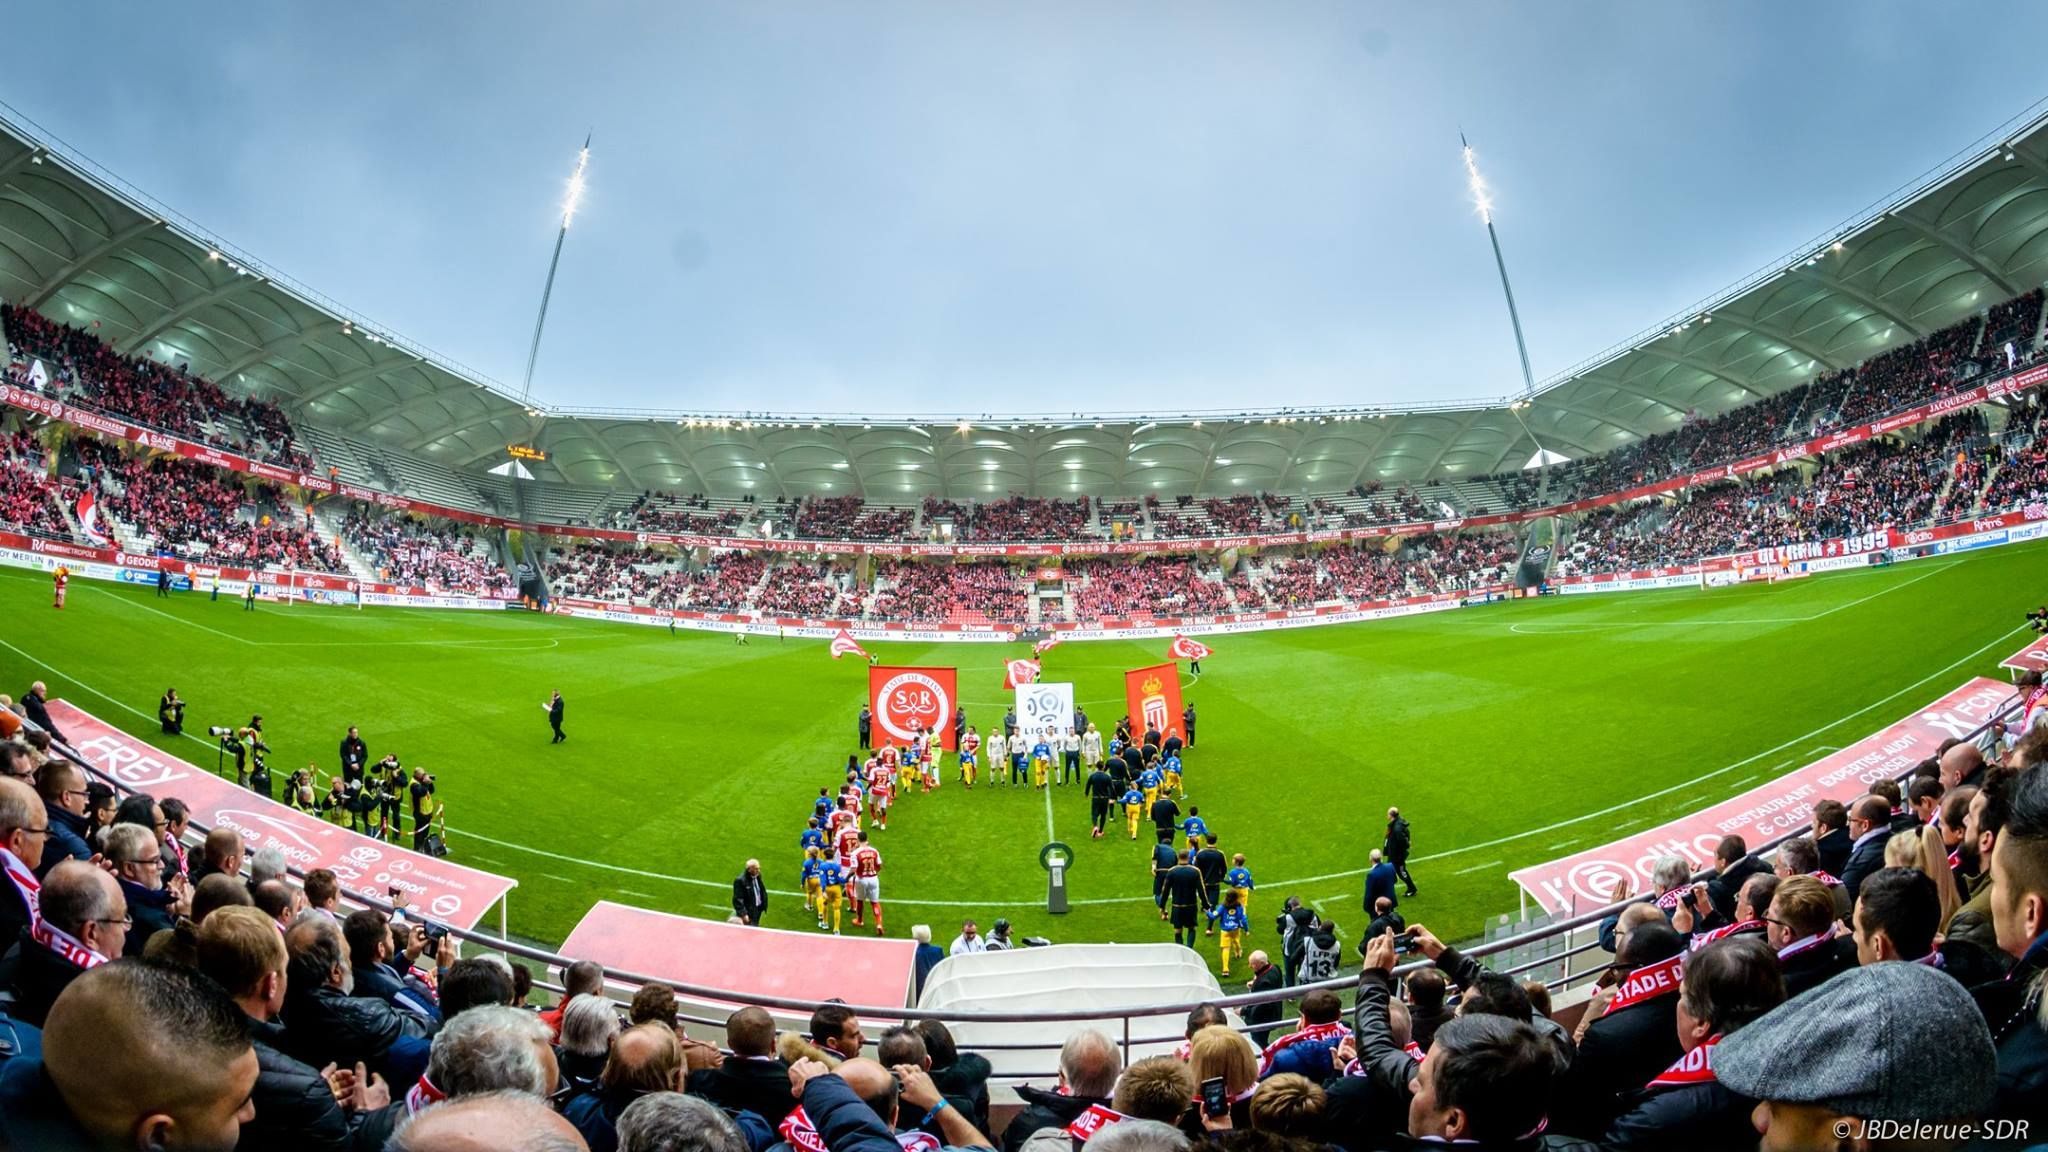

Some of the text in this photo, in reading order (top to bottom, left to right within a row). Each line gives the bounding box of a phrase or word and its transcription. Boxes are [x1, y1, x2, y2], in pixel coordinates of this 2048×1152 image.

[1929, 390, 1978, 413] JACQUESON
[307, 478, 332, 491] GEODIS
[1222, 539, 1250, 547] EIFFAGE
[1268, 536, 1299, 545] NOVOTEL
[12, 552, 44, 564] MERLIN
[126, 555, 160, 568] GEODIS
[613, 612, 639, 621] SEGULA
[1285, 617, 1315, 625] SEGULA
[1335, 612, 1364, 621] SEGULA
[851, 621, 886, 630] SOS MALUS
[1234, 621, 1264, 629] SEGULA
[896, 690, 932, 705] S R
[1955, 687, 2003, 718] FCN
[1025, 727, 1059, 735] LIGUE
[79, 735, 191, 786] FREY
[1818, 732, 1920, 788] EXPERTISE AUDIT
[1859, 754, 1916, 785] CONSEIL
[1716, 783, 1820, 834] RESTAURANT
[1756, 819, 1774, 836] &
[340, 855, 370, 871] TOYOTA
[389, 879, 427, 896] smart
[1309, 960, 1332, 978] 13
[1615, 972, 1670, 1003] STADE
